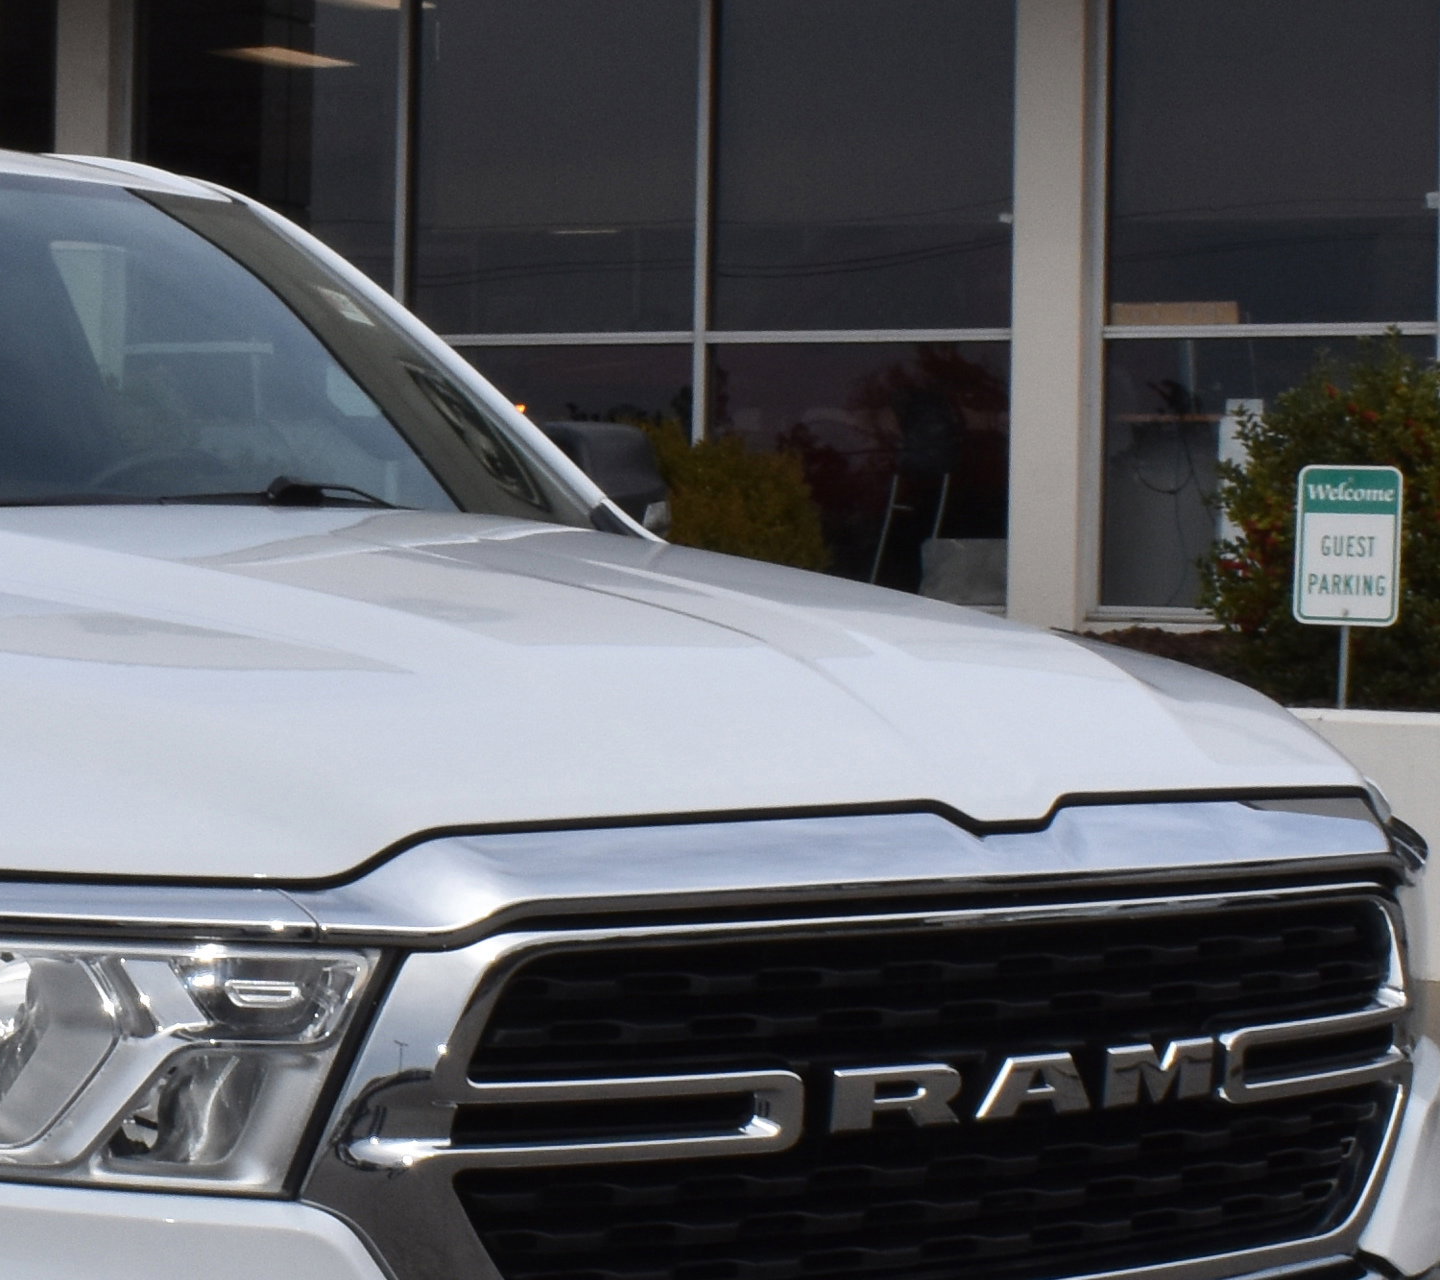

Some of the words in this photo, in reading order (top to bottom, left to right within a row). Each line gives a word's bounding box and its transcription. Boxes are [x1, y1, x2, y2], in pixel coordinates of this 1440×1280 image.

[1307, 482, 1395, 502] Welcome
[1321, 534, 1376, 557] GUEST
[1307, 573, 1386, 596] PARKING
[830, 1036, 1216, 1134] RAM
